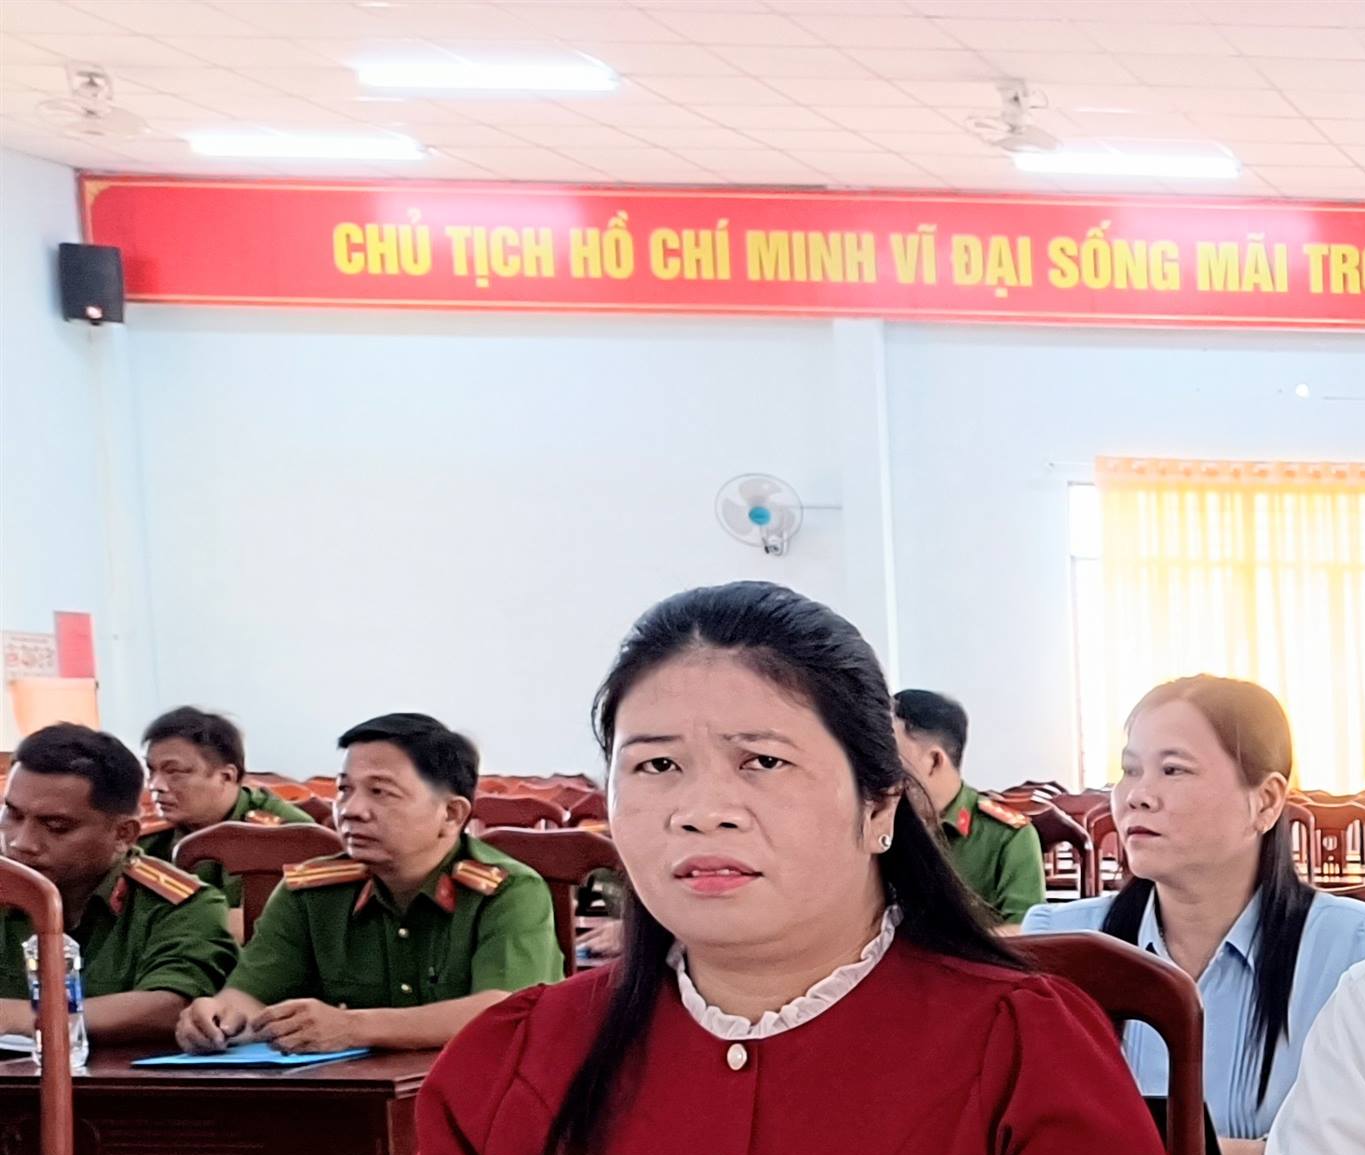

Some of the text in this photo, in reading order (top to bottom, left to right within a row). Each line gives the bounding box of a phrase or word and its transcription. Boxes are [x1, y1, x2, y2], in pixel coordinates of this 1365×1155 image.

[332, 207, 432, 276] CHỦ
[444, 225, 556, 288] TỊCH
[569, 210, 635, 280] HỒ
[648, 218, 731, 281] CHÍ
[745, 230, 878, 284] MINH
[889, 223, 938, 286] VĨ
[949, 233, 1034, 299] ĐẠI
[1047, 219, 1181, 291] SỐNG
[1195, 232, 1289, 293] MÃI
